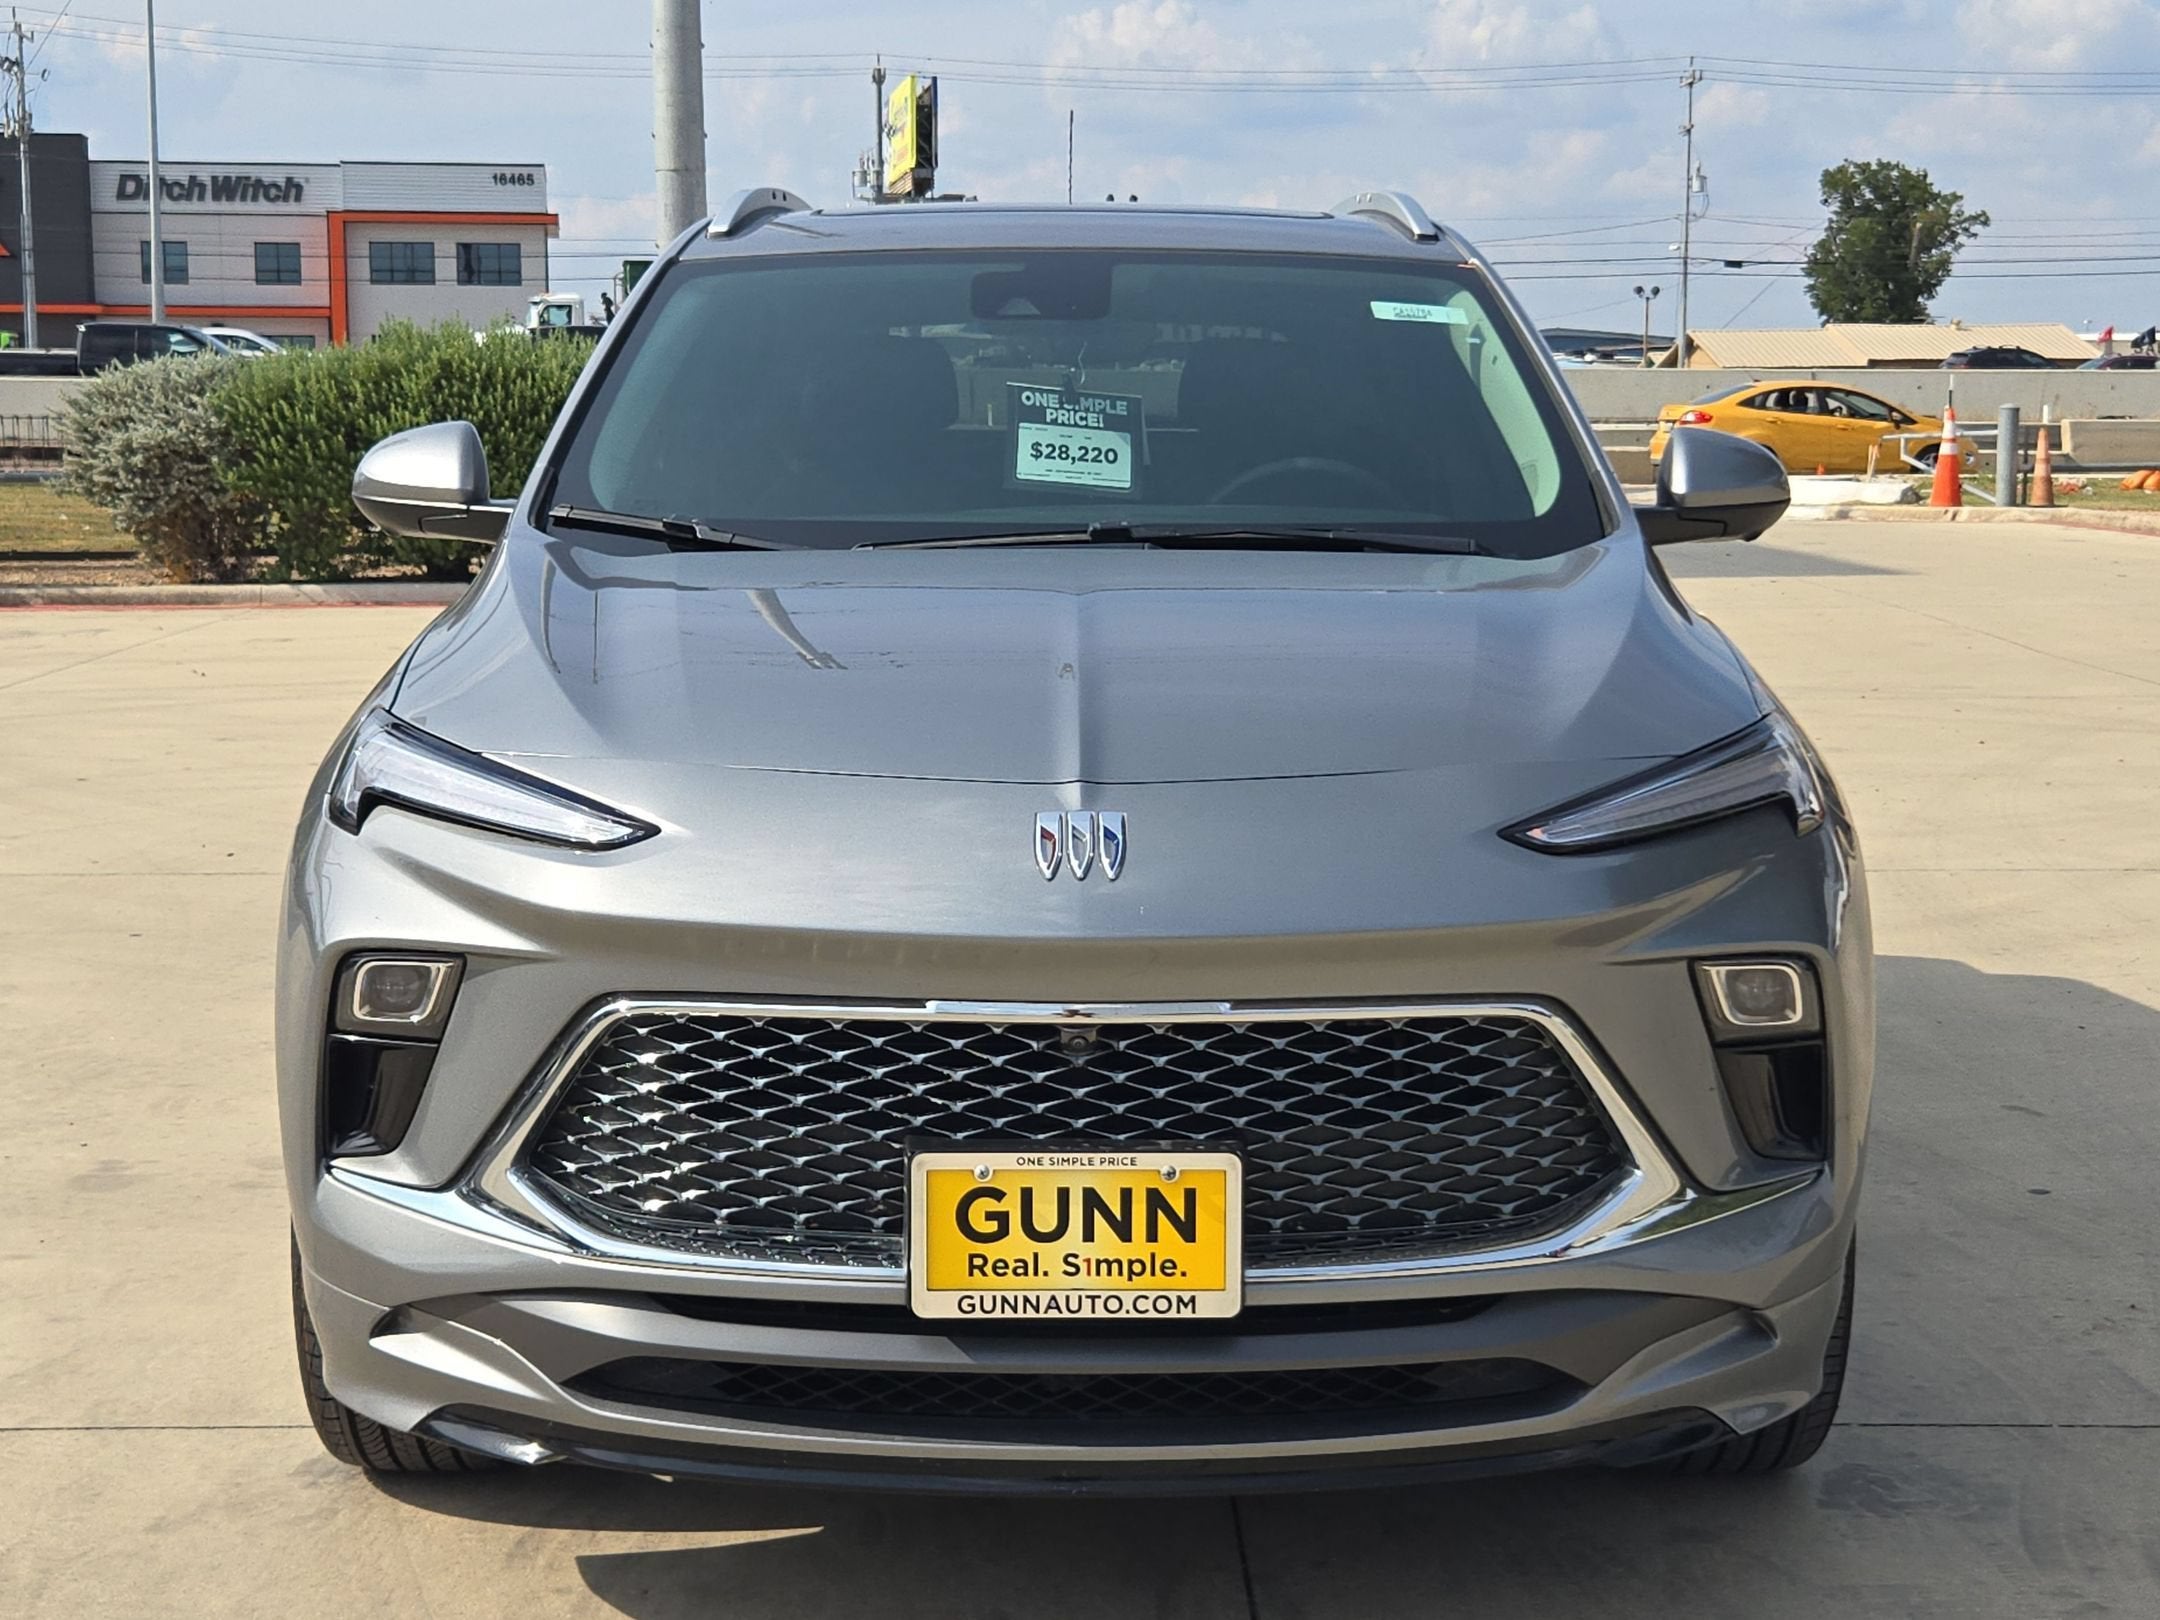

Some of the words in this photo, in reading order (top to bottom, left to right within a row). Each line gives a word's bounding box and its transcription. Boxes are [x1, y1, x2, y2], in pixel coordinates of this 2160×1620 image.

[210, 175, 304, 203] Witch
[491, 172, 535, 186] 16465
[1021, 390, 1060, 409] ONE
[1029, 440, 1119, 465] $28,220
[1016, 1156, 1045, 1167] ONE
[1048, 1156, 1095, 1167] SIMPLE
[1099, 1156, 1138, 1167] PRICE
[955, 1186, 1197, 1244] GUNN
[967, 1252, 1049, 1278] Real.
[957, 1294, 1197, 1315] GUNNAUTO.COM
